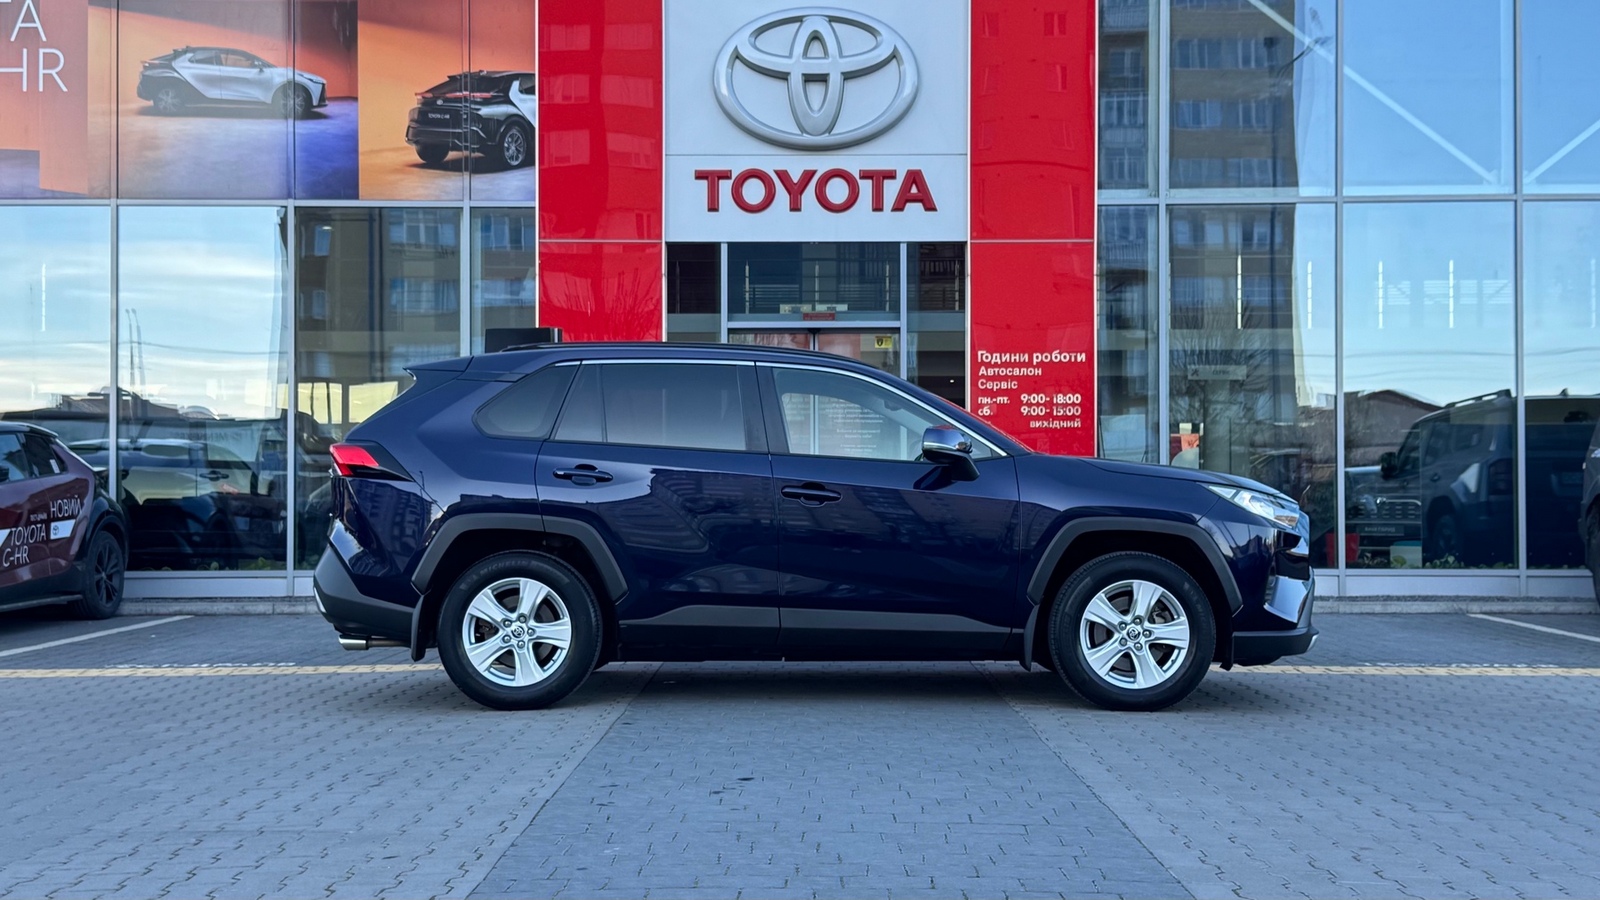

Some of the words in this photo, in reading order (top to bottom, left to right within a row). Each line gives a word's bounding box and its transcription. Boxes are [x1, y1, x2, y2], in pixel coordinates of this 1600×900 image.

[694, 168, 938, 214] TOYOTA
[977, 350, 1029, 364] Години
[1033, 350, 1086, 366] роботи
[979, 366, 1042, 376] Автосалон
[978, 379, 1018, 391] Сервіс
[1053, 406, 1081, 416] 15:00
[1030, 418, 1081, 429] вихідний
[50, 494, 82, 518] НОВИЙ
[11, 523, 46, 546] TOYOTA
[2, 545, 30, 567] C-HR
